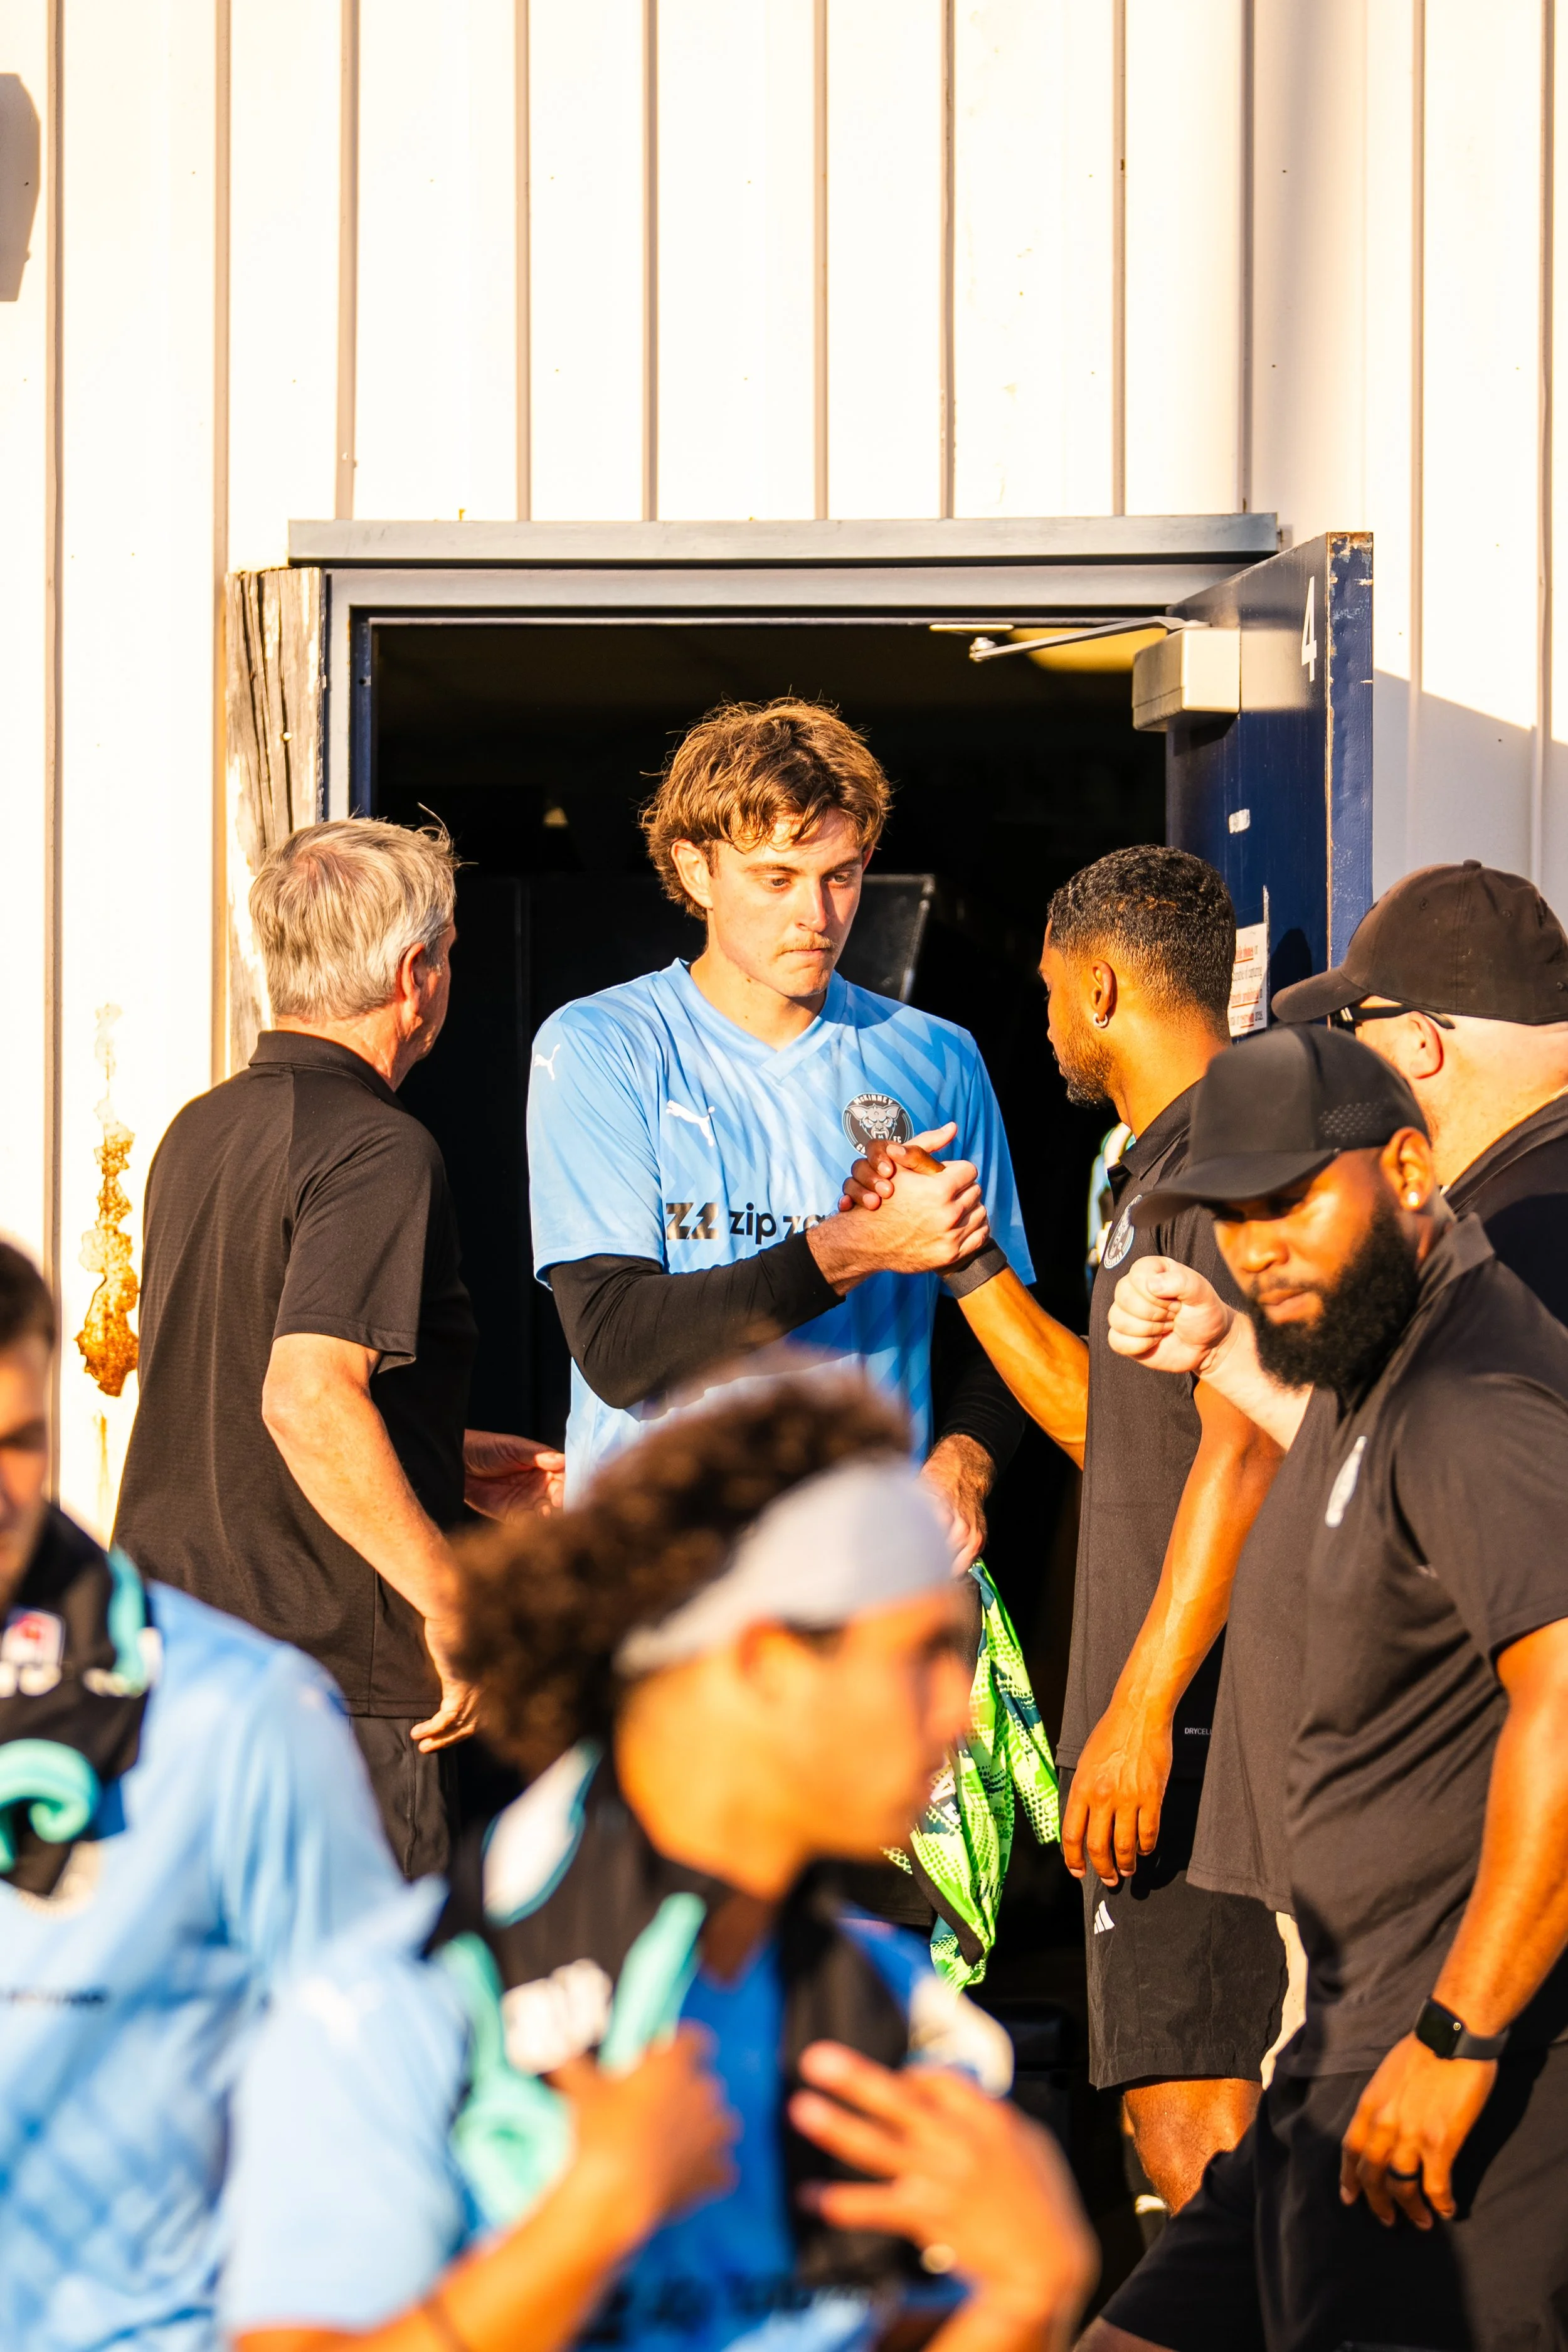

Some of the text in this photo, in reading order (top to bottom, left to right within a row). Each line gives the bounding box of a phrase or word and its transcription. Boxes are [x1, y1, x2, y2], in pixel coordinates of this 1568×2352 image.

[1301, 576, 1317, 682] 4
[729, 1202, 825, 1245] zip zo
